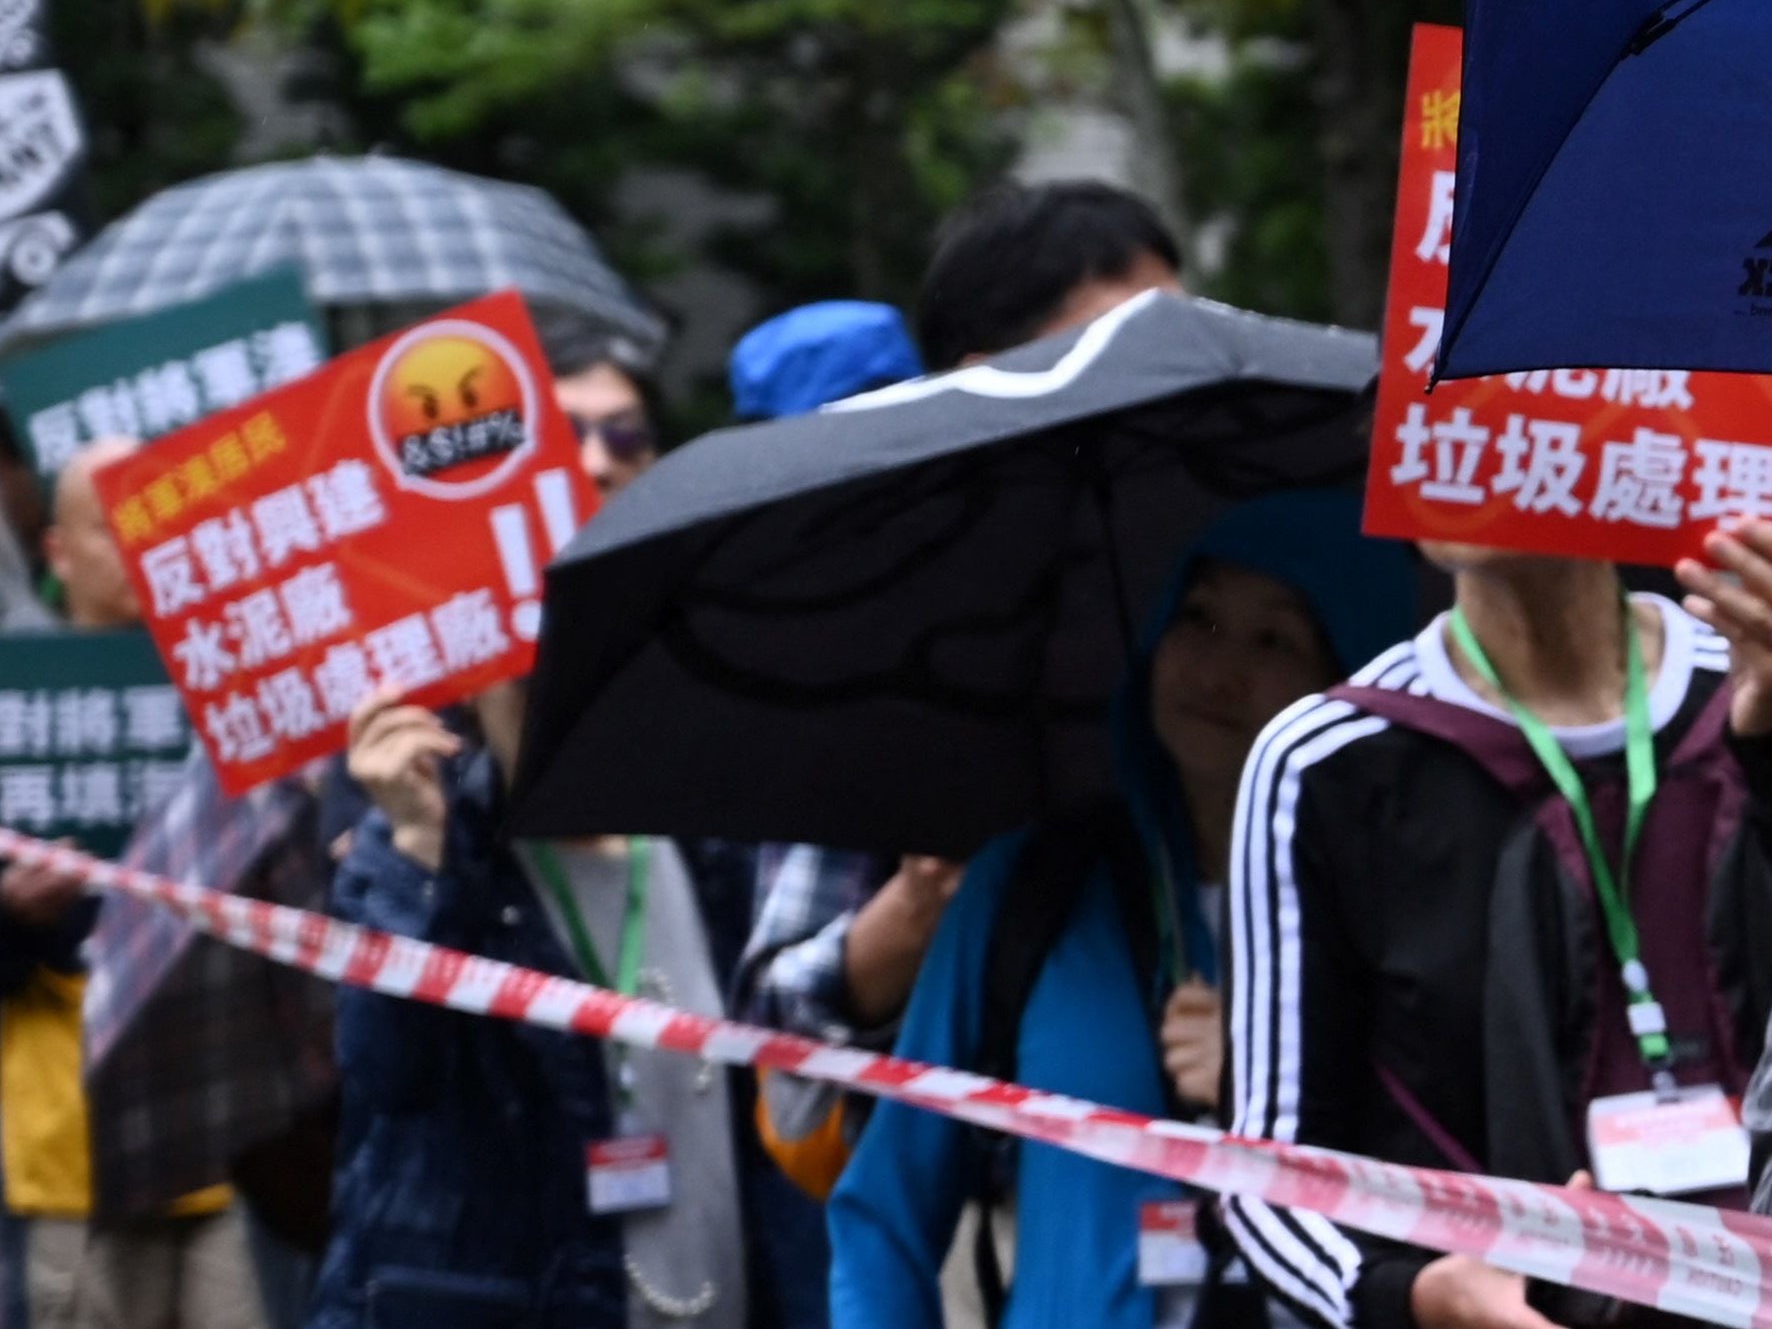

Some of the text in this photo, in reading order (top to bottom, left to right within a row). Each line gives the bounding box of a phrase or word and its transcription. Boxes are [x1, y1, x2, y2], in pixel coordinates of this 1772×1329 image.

[141, 458, 387, 617] 反對興建
[173, 562, 352, 690] 水泥廠
[204, 588, 510, 763] 垃圾處理廠
